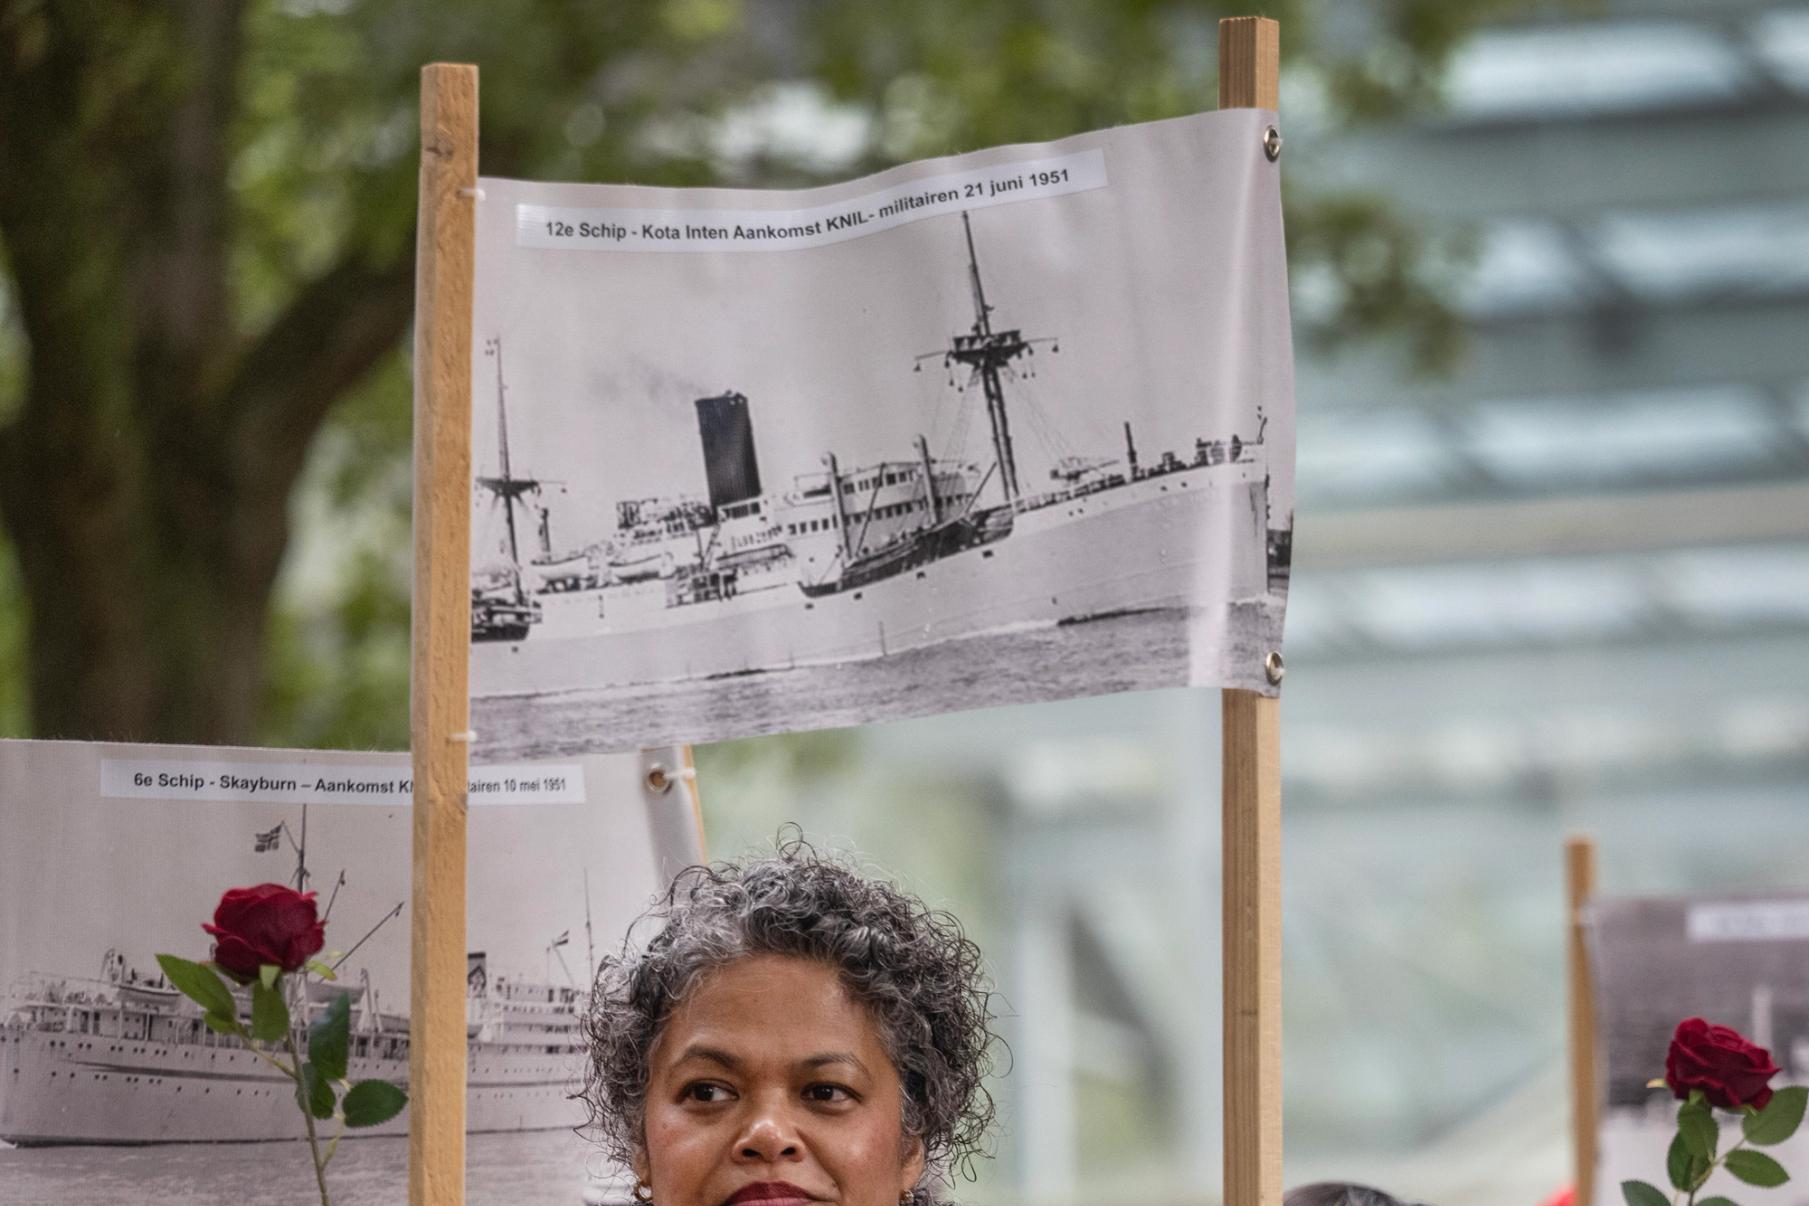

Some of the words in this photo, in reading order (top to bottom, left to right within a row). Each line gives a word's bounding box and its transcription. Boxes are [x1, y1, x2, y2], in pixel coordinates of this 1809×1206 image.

[546, 221, 574, 237] 12e
[579, 223, 627, 242] Schip
[642, 224, 680, 240] Kota
[686, 225, 728, 240] Inten
[733, 219, 822, 240] Aankomst
[879, 188, 959, 219] militairen
[964, 182, 984, 198] 21
[989, 175, 1023, 197] juni
[1029, 168, 1069, 188] 1951
[134, 772, 152, 787] 6e
[158, 773, 204, 790] Schip
[219, 775, 297, 793] Skayburn
[315, 778, 394, 794] Aankomst
[504, 779, 516, 792] 10
[520, 778, 540, 791] mei
[544, 777, 566, 791] 1951
